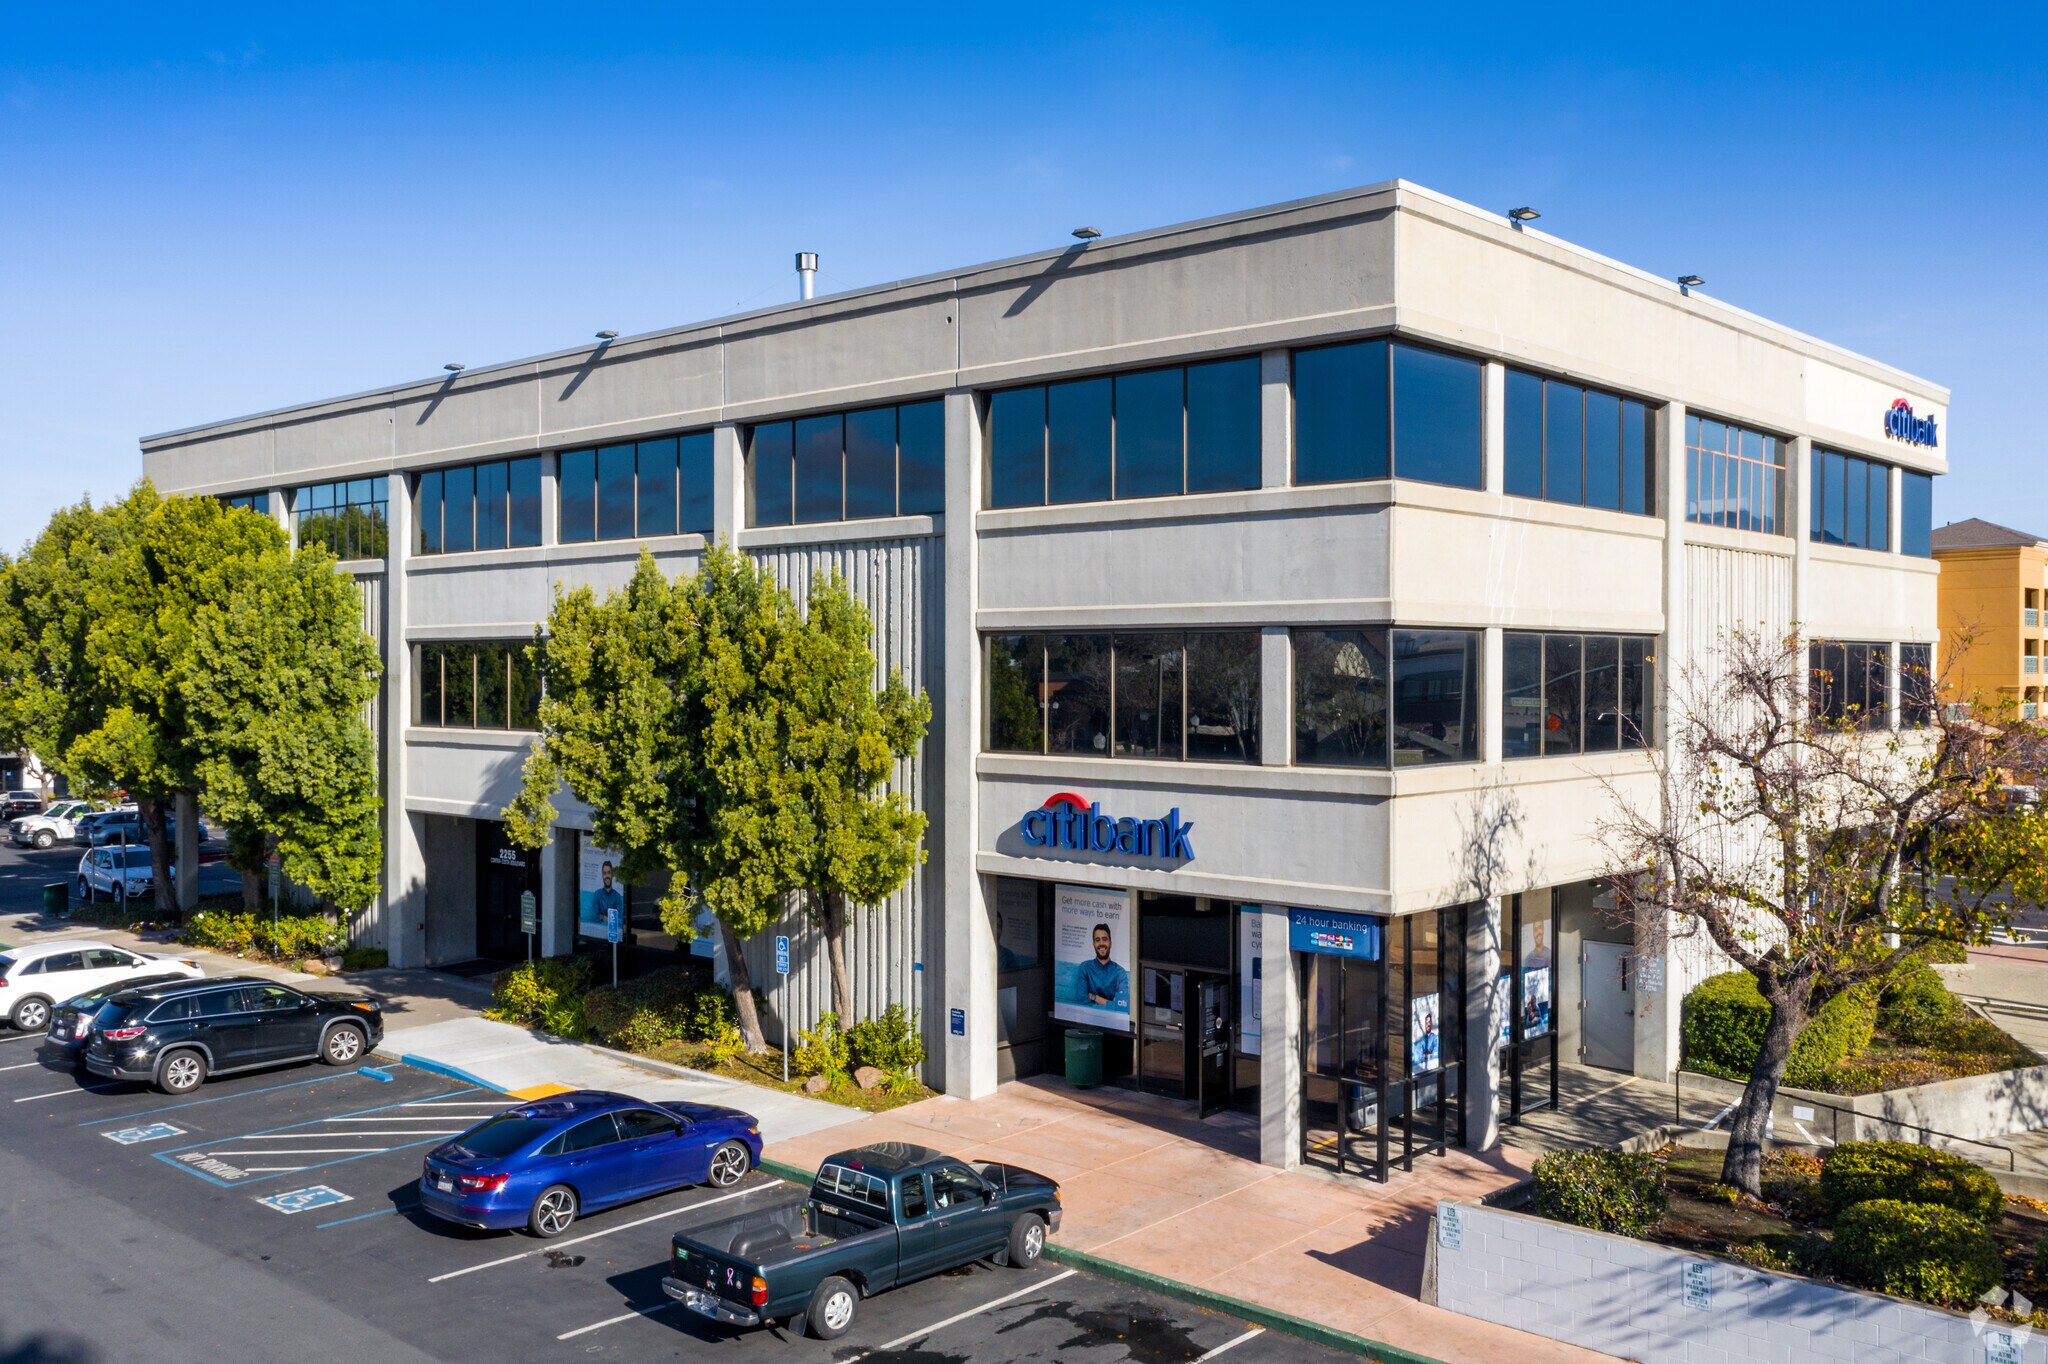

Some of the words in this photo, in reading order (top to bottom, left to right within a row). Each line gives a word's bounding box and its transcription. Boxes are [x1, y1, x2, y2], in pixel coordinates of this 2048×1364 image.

[1883, 398, 1938, 447] citibank
[1020, 793, 1195, 860] citibank
[499, 848, 516, 860] 2255
[1061, 896, 1073, 904] Get
[1074, 898, 1091, 906] more
[1091, 900, 1107, 908] cash
[1108, 901, 1122, 910] with
[1061, 906, 1078, 914] more
[1079, 909, 1095, 917] ways
[1104, 911, 1120, 919] earn
[1251, 918, 1262, 927] Ba
[1295, 914, 1307, 925] 24
[1309, 916, 1330, 928] hour
[1332, 920, 1368, 934] banking
[1251, 930, 1262, 938] wa
[176, 1152, 207, 1162] NO
[192, 1158, 250, 1180] PARKING
[1442, 1225, 1460, 1234] PARKING
[1693, 1263, 1702, 1273] 15
[1687, 1272, 1707, 1280] MINUTE
[1685, 1283, 1709, 1293] PARKING
[1998, 1351, 2012, 1359] ATM
